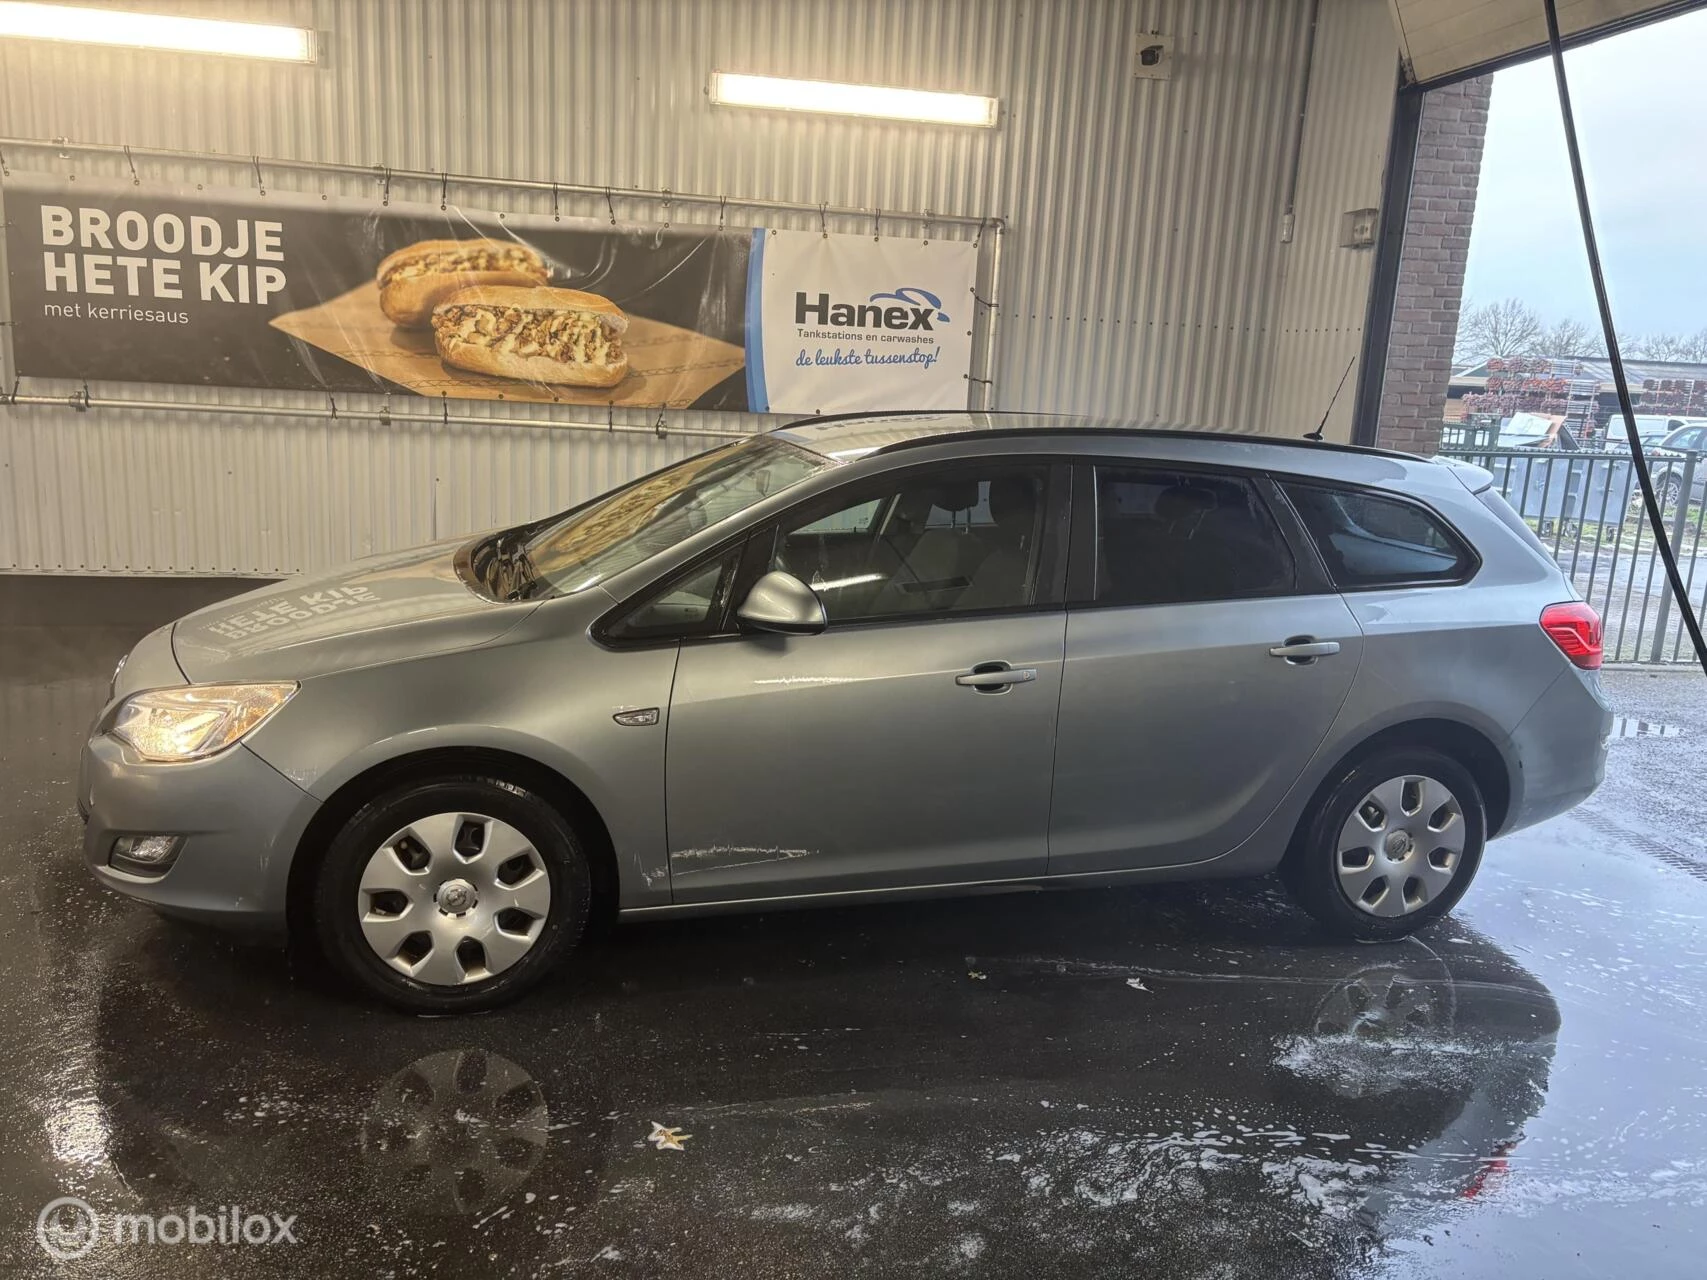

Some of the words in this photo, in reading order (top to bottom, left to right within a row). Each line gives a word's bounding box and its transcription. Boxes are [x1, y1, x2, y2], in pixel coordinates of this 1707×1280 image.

[40, 204, 285, 262] BROODJE
[43, 251, 183, 299] HETE
[199, 261, 287, 305] KIP
[44, 303, 82, 318] met
[87, 302, 190, 324] kerriesaus
[795, 291, 935, 331] Hanex
[797, 328, 863, 341] Tankstations
[865, 333, 878, 342] en
[880, 333, 934, 344] carwashes
[795, 348, 813, 367] de
[815, 348, 863, 366] leukste
[863, 345, 941, 370] tussenstop!
